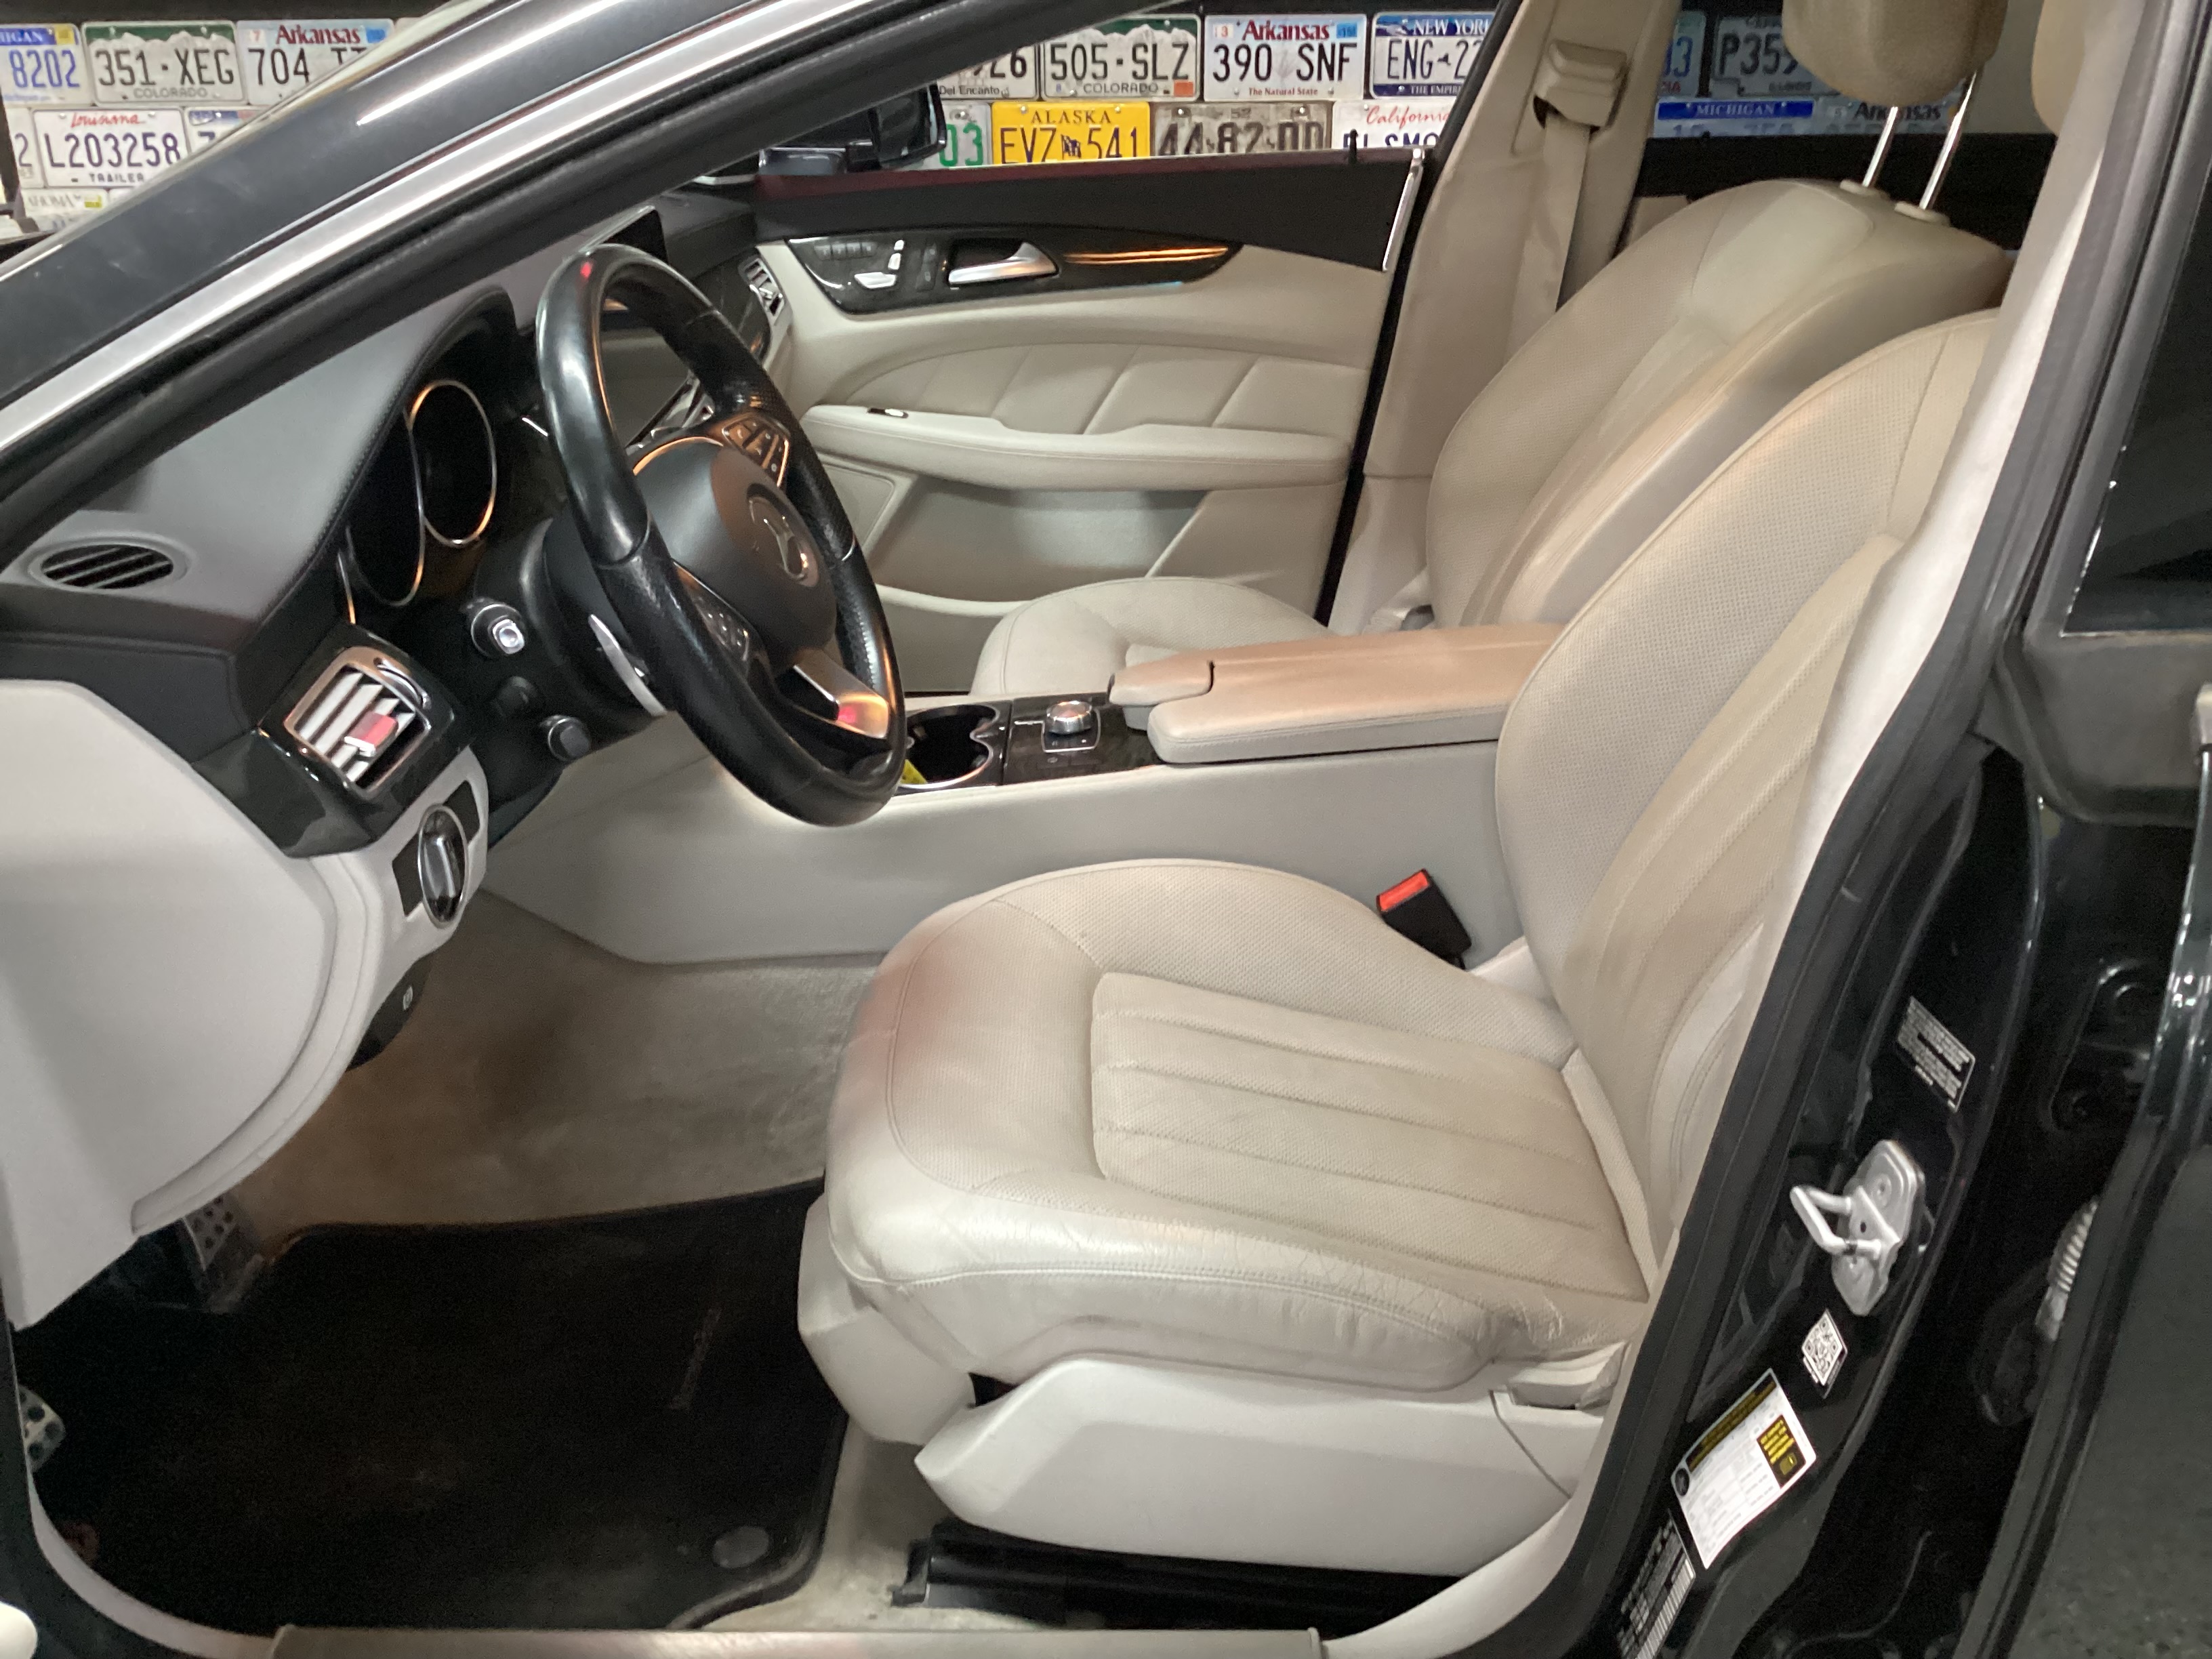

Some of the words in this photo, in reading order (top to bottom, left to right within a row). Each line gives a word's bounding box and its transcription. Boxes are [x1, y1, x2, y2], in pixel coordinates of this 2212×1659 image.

[275, 24, 361, 44] Arkansas
[1242, 20, 1331, 41] Arkansas
[1413, 19, 1449, 35] NEW
[248, 47, 310, 85] 704
[1213, 43, 1273, 82] 390
[1296, 42, 1357, 81] SNF
[1387, 39, 1433, 79] ENG
[9, 49, 80, 87] 8202
[134, 87, 208, 98] COLORADO
[1084, 83, 1159, 94] COLORADO
[1249, 87, 1262, 96] The
[1265, 87, 1295, 96] Natural
[1297, 87, 1318, 96] State
[1410, 85, 1428, 94] THE
[1031, 110, 1111, 124] ALASKA
[1696, 104, 1774, 116] MICHIGAN
[70, 112, 145, 128] Louisiana
[44, 132, 181, 168] L203258
[1088, 127, 1138, 159] 541
[89, 173, 145, 183] TRAILER
